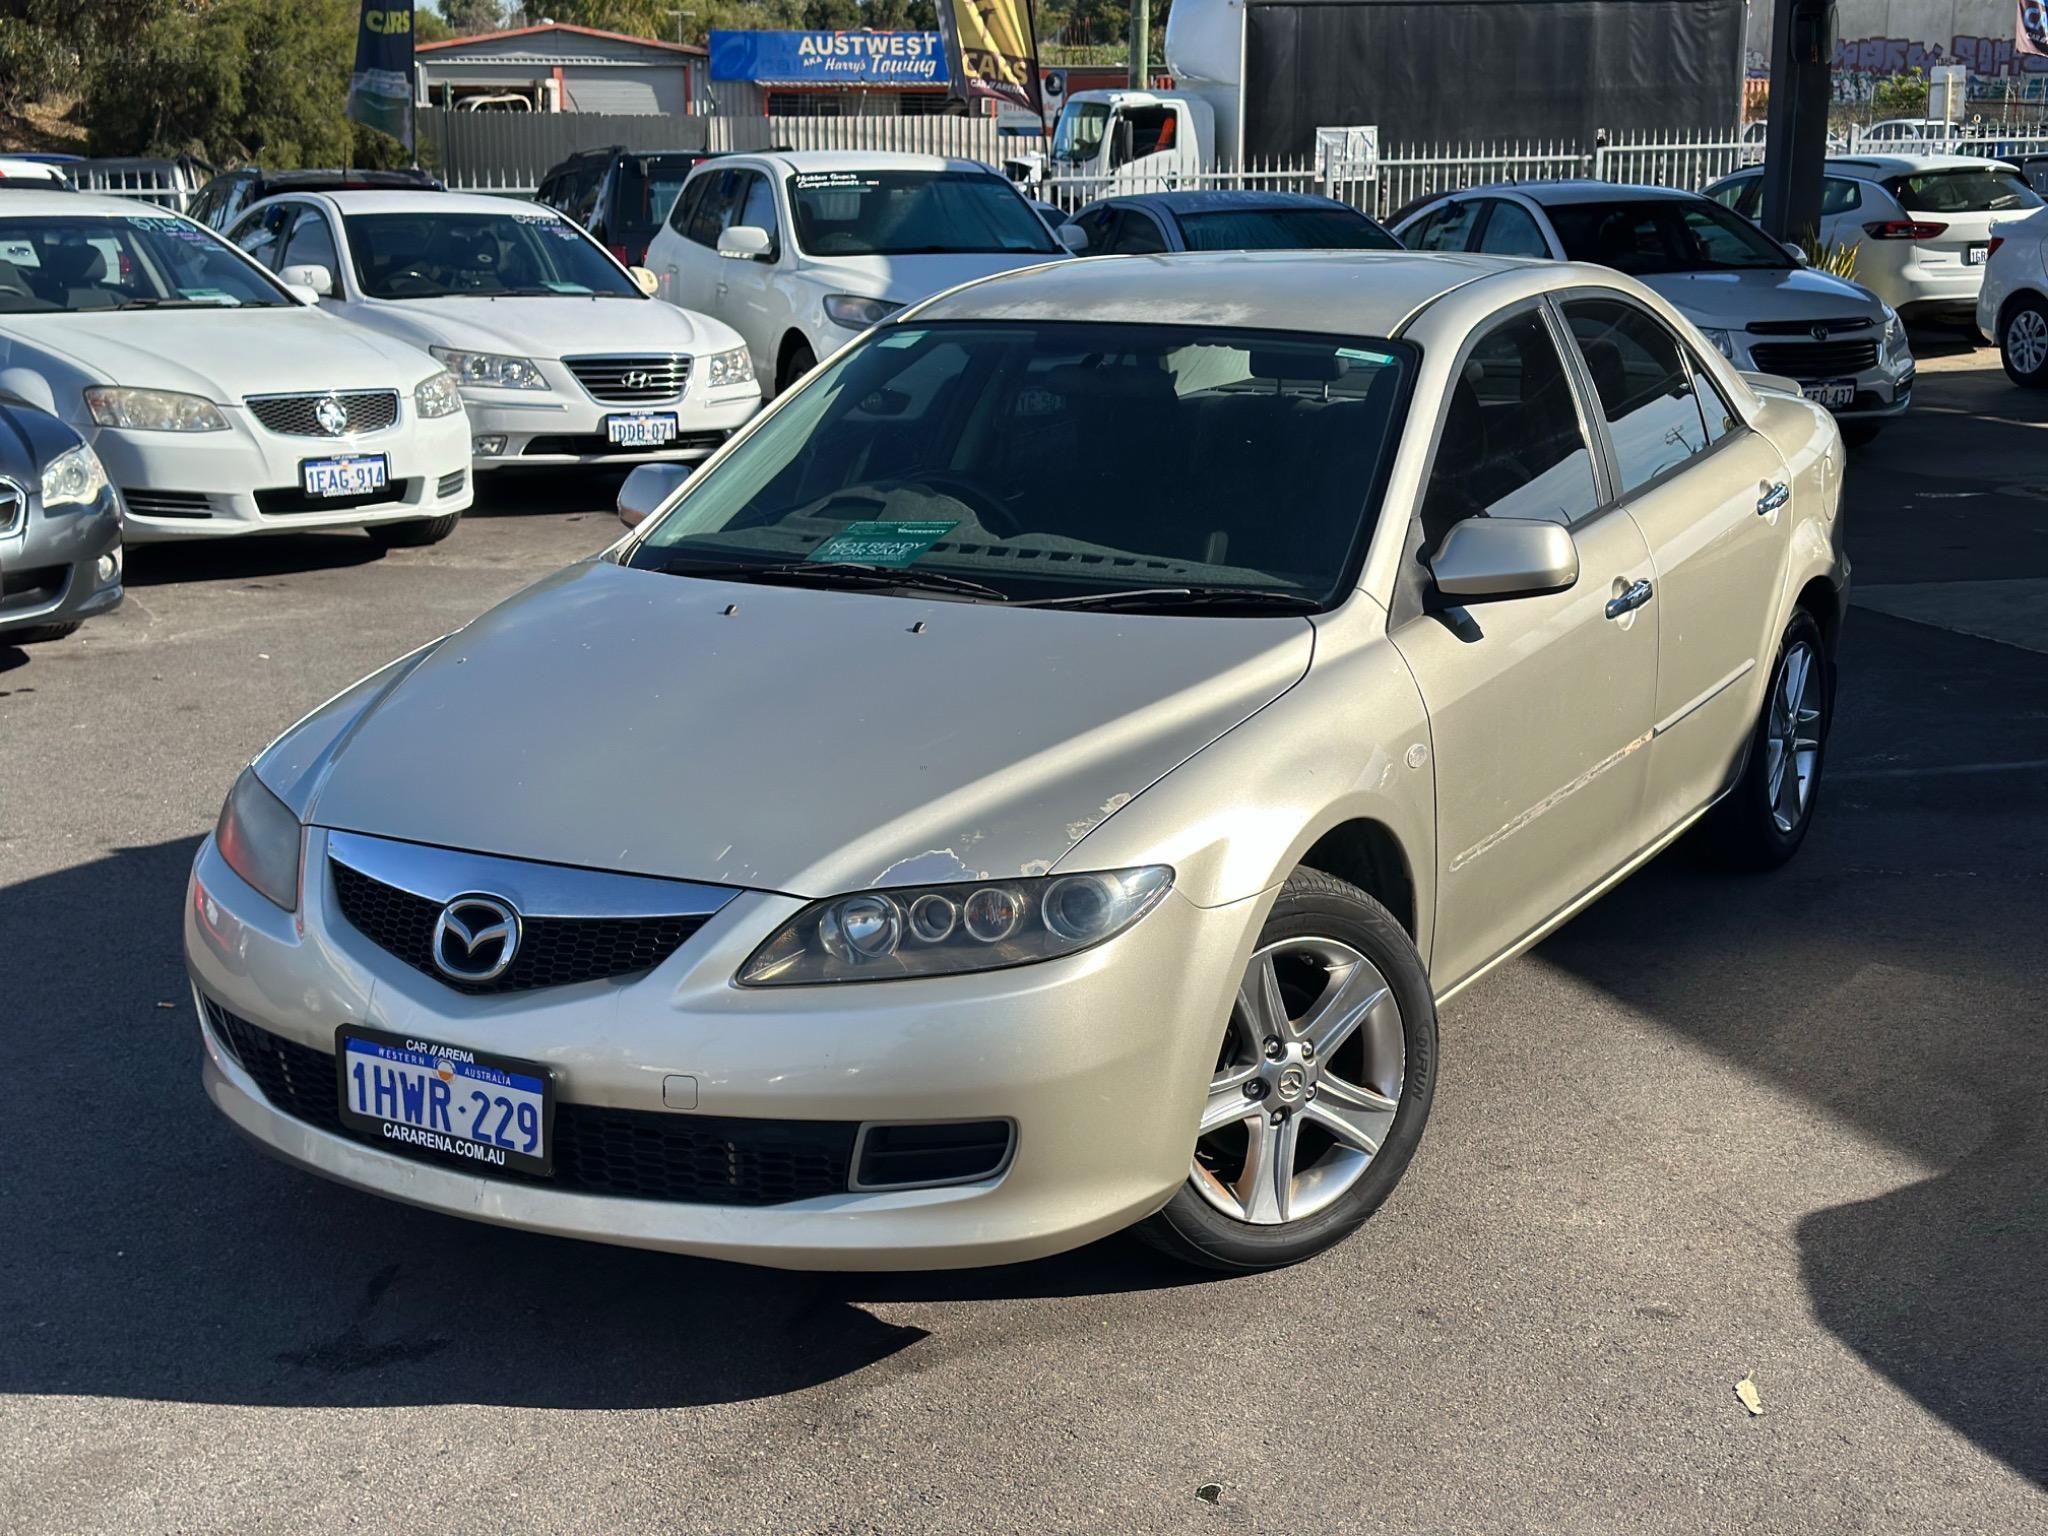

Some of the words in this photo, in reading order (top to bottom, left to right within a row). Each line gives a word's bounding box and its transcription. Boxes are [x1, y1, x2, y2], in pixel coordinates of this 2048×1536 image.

[366, 9, 411, 34] CARS
[798, 35, 937, 56] AUSTWEST
[824, 57, 866, 73] Harry's
[871, 54, 937, 78] Towing
[962, 52, 1029, 86] CARS
[405, 1039, 428, 1054] CAR
[378, 1047, 425, 1066] WESTERN
[464, 1067, 512, 1087] AUSTRALIA
[383, 1122, 506, 1166] CARARENA.COM.AU
